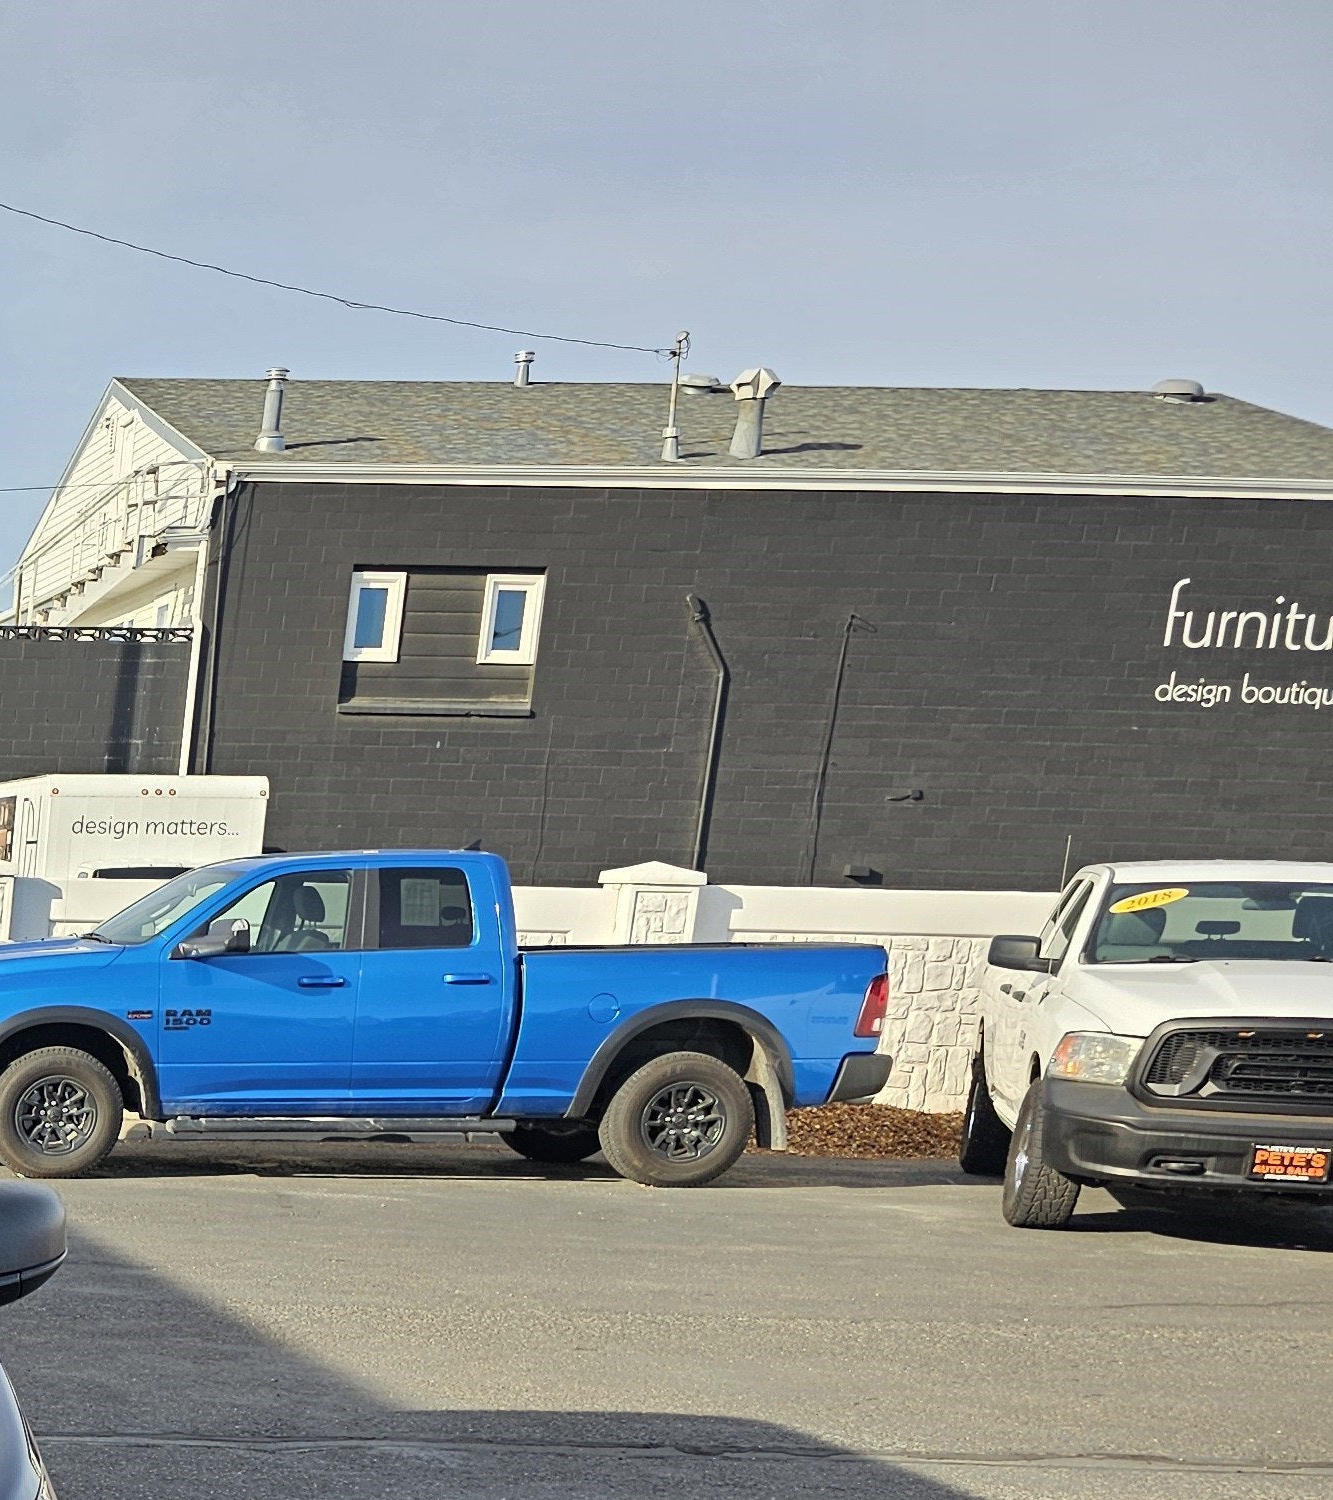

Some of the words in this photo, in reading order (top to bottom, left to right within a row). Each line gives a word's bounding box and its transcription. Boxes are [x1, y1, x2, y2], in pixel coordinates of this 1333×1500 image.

[1154, 670, 1232, 708] design
[71, 815, 139, 840] design
[1125, 891, 1172, 910] 2018
[165, 1009, 212, 1017] RAM
[1255, 1149, 1326, 1168] PETE'S
